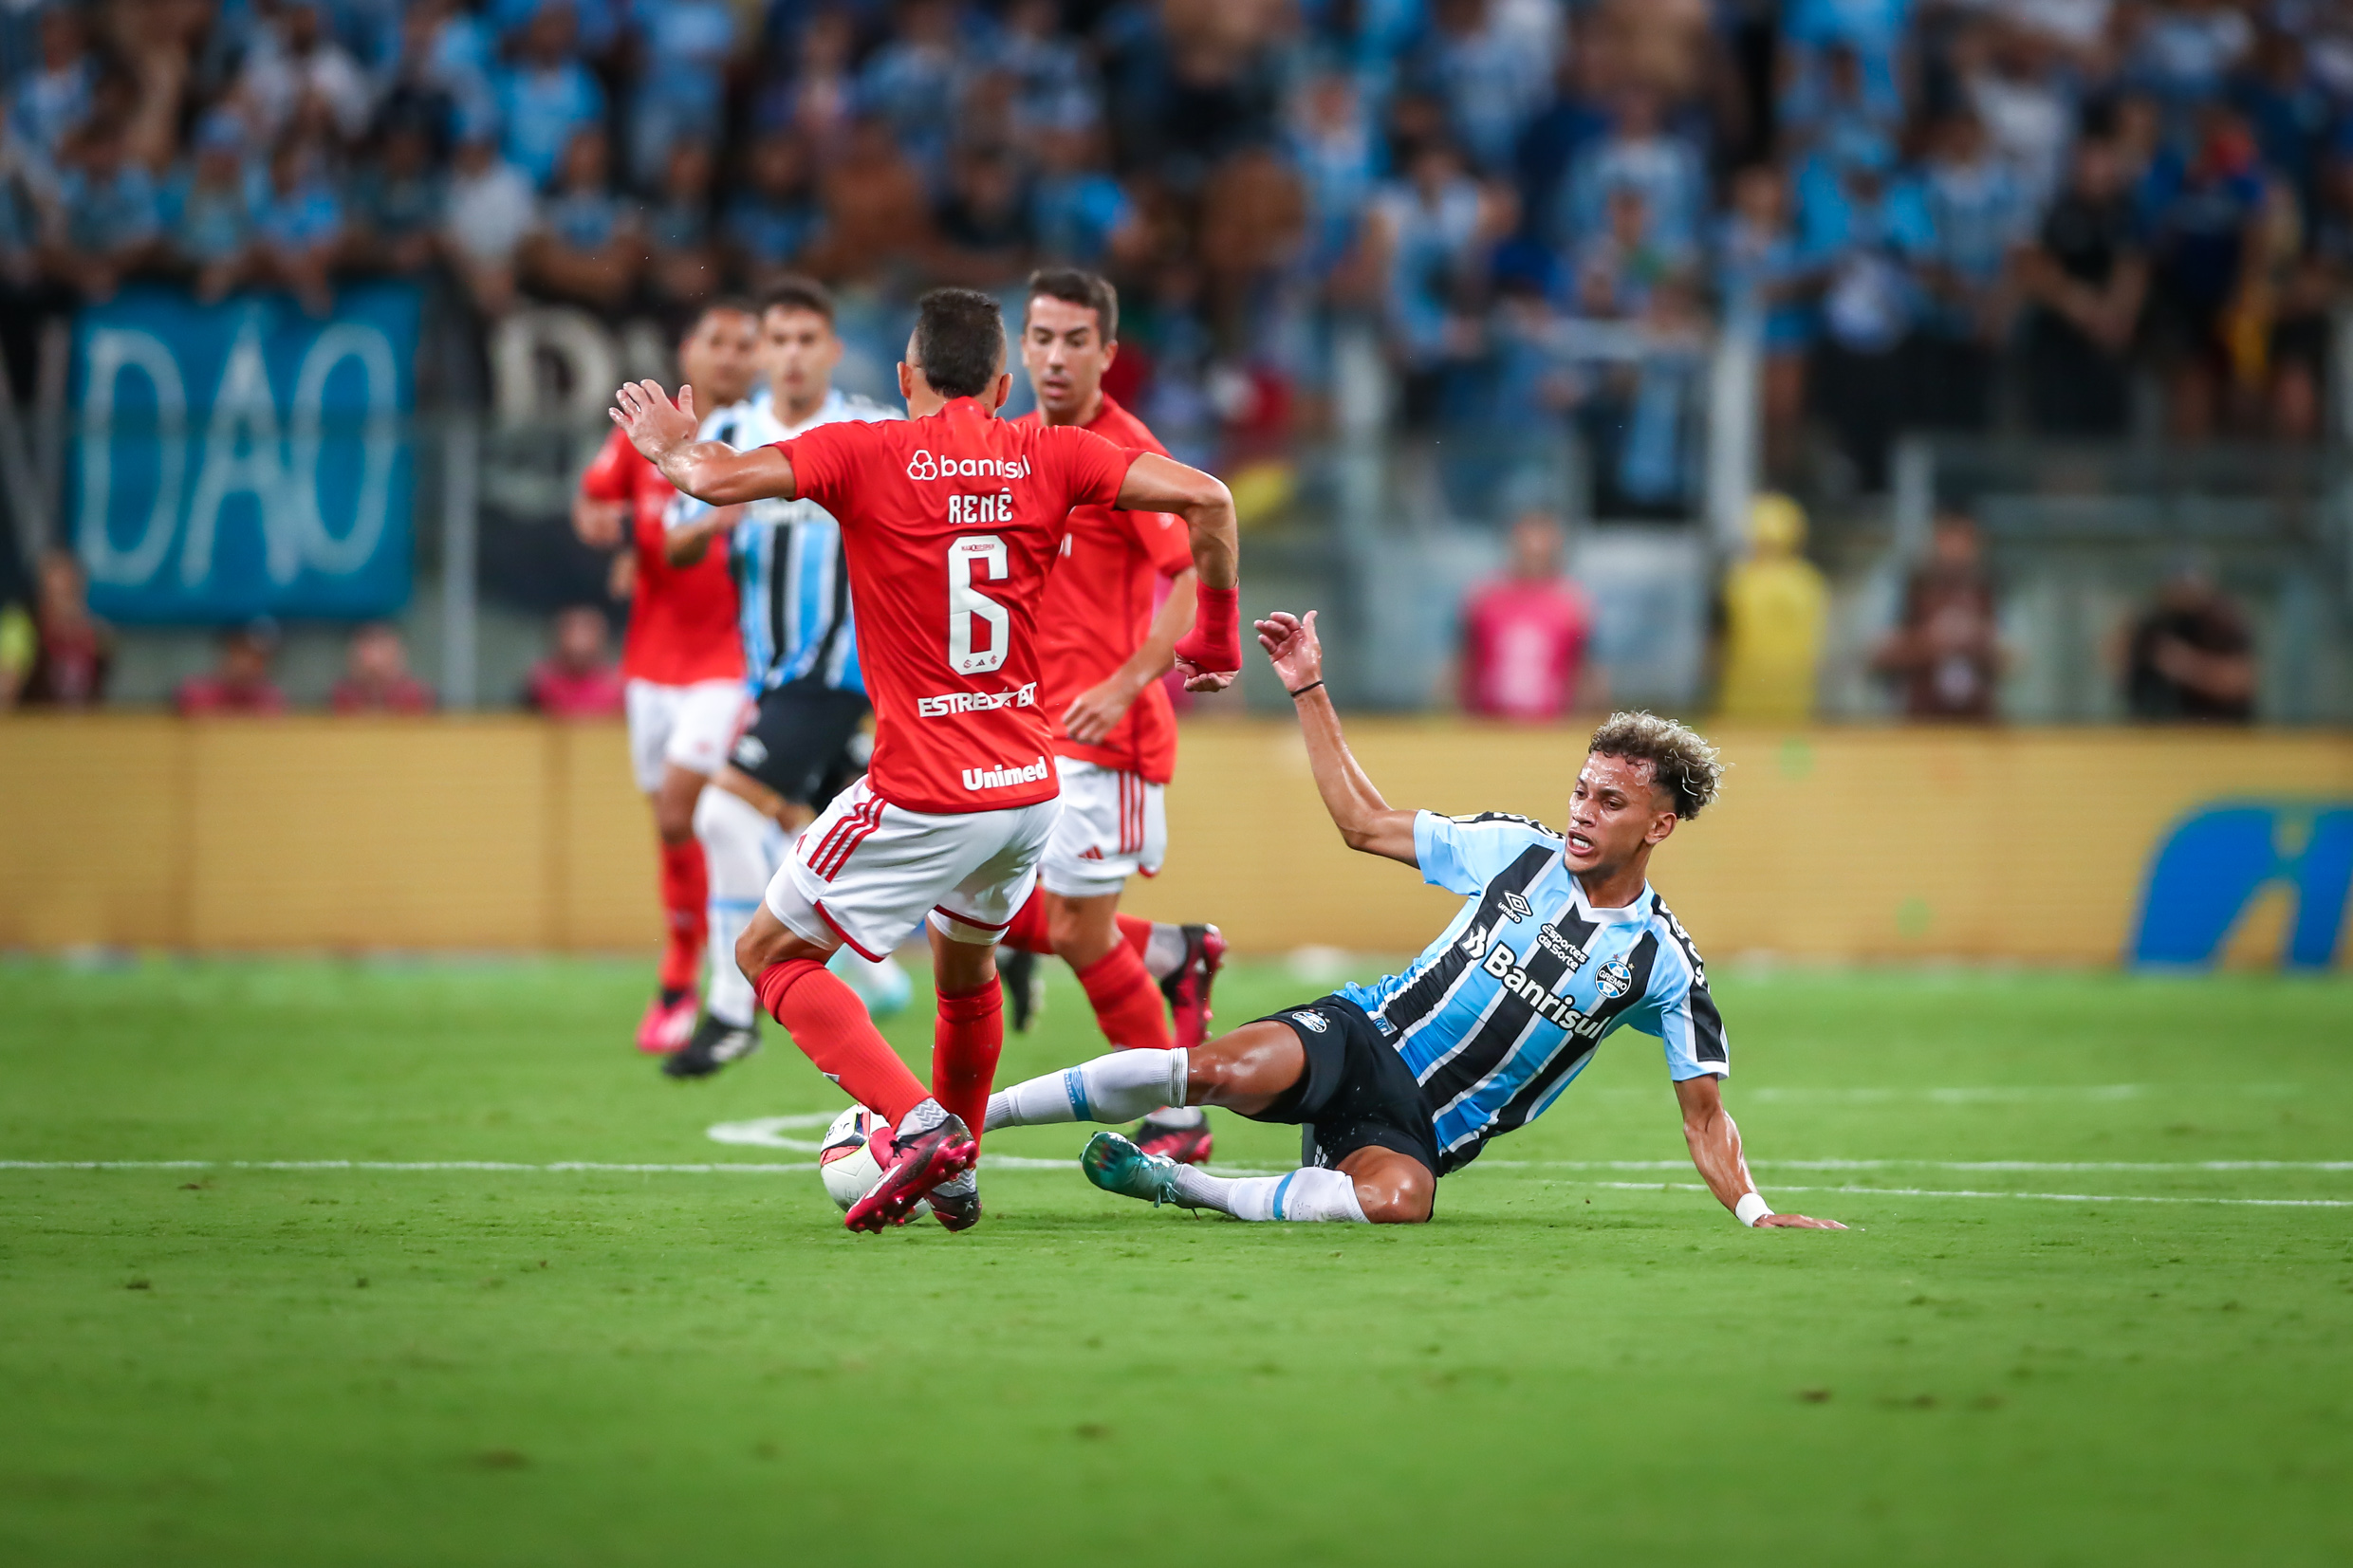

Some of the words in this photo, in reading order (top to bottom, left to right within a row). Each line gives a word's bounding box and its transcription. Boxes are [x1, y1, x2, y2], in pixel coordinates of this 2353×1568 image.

[948, 534, 1010, 675] 6
[962, 756, 1048, 791] Unimed
[1497, 901, 1521, 923] umbro
[1542, 924, 1587, 964] Esportes
[1483, 943, 1611, 1039] Banrisul
